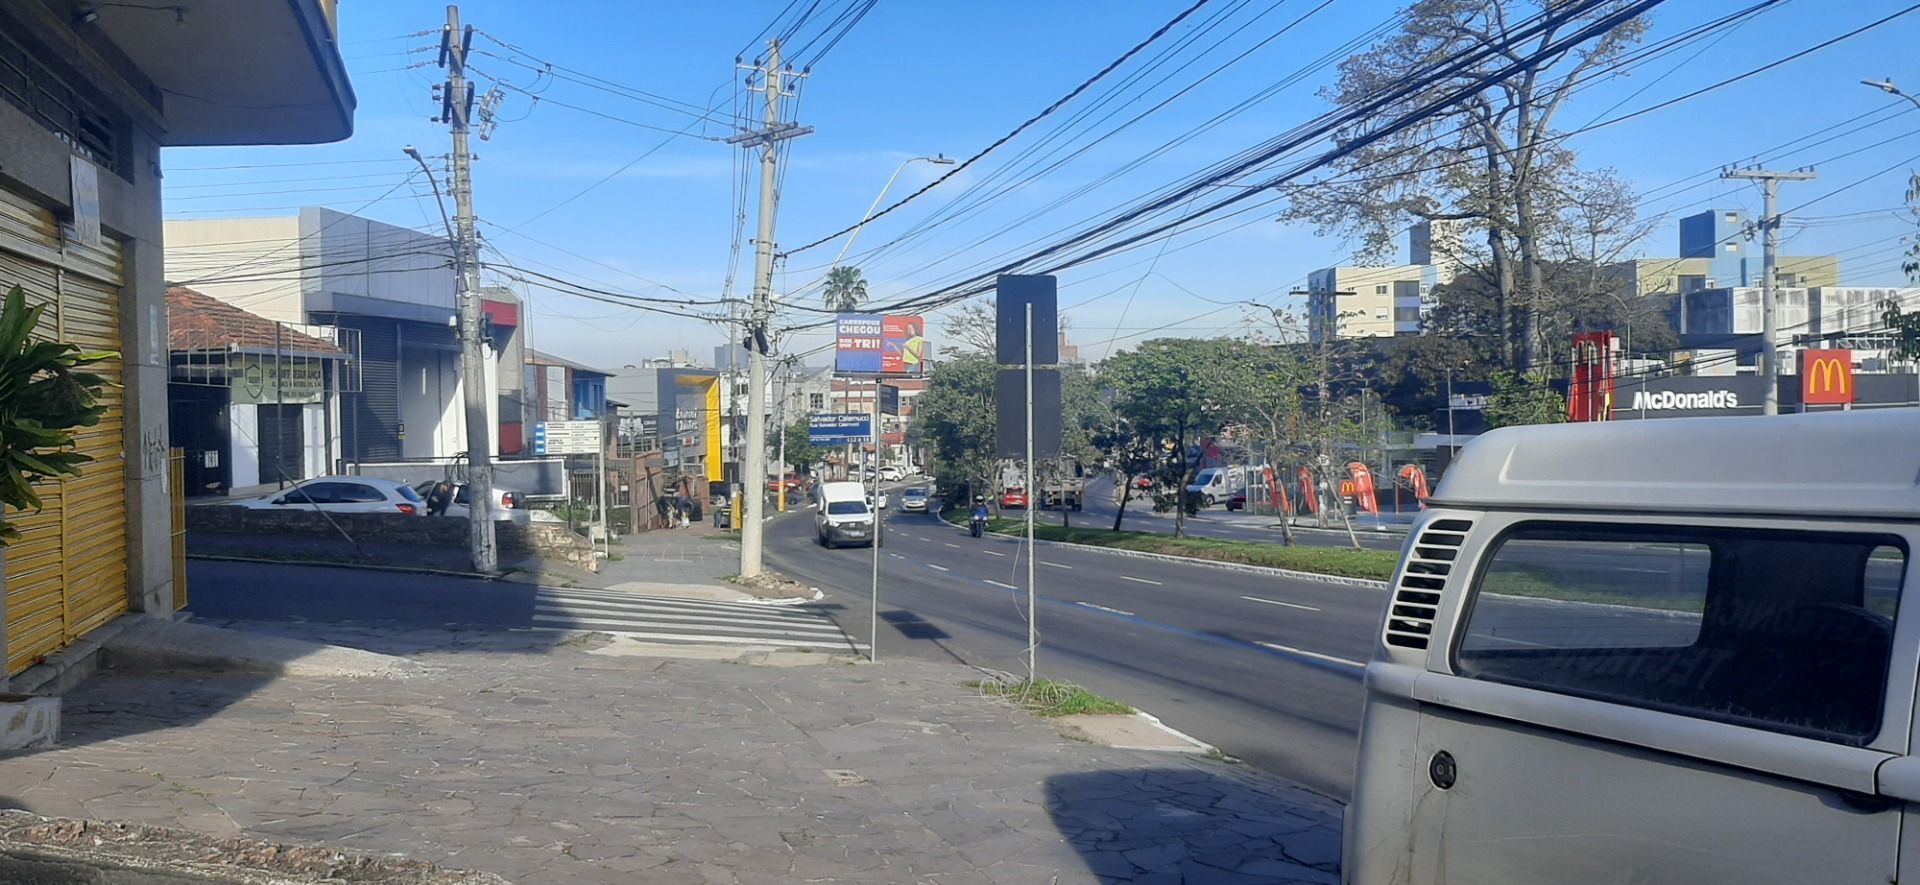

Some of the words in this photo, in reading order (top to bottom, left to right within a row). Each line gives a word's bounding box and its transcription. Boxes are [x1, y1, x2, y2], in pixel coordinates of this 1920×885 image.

[839, 325, 881, 334] CHEGOU
[854, 338, 881, 349] TRI!
[1632, 390, 1738, 409] McDonald's
